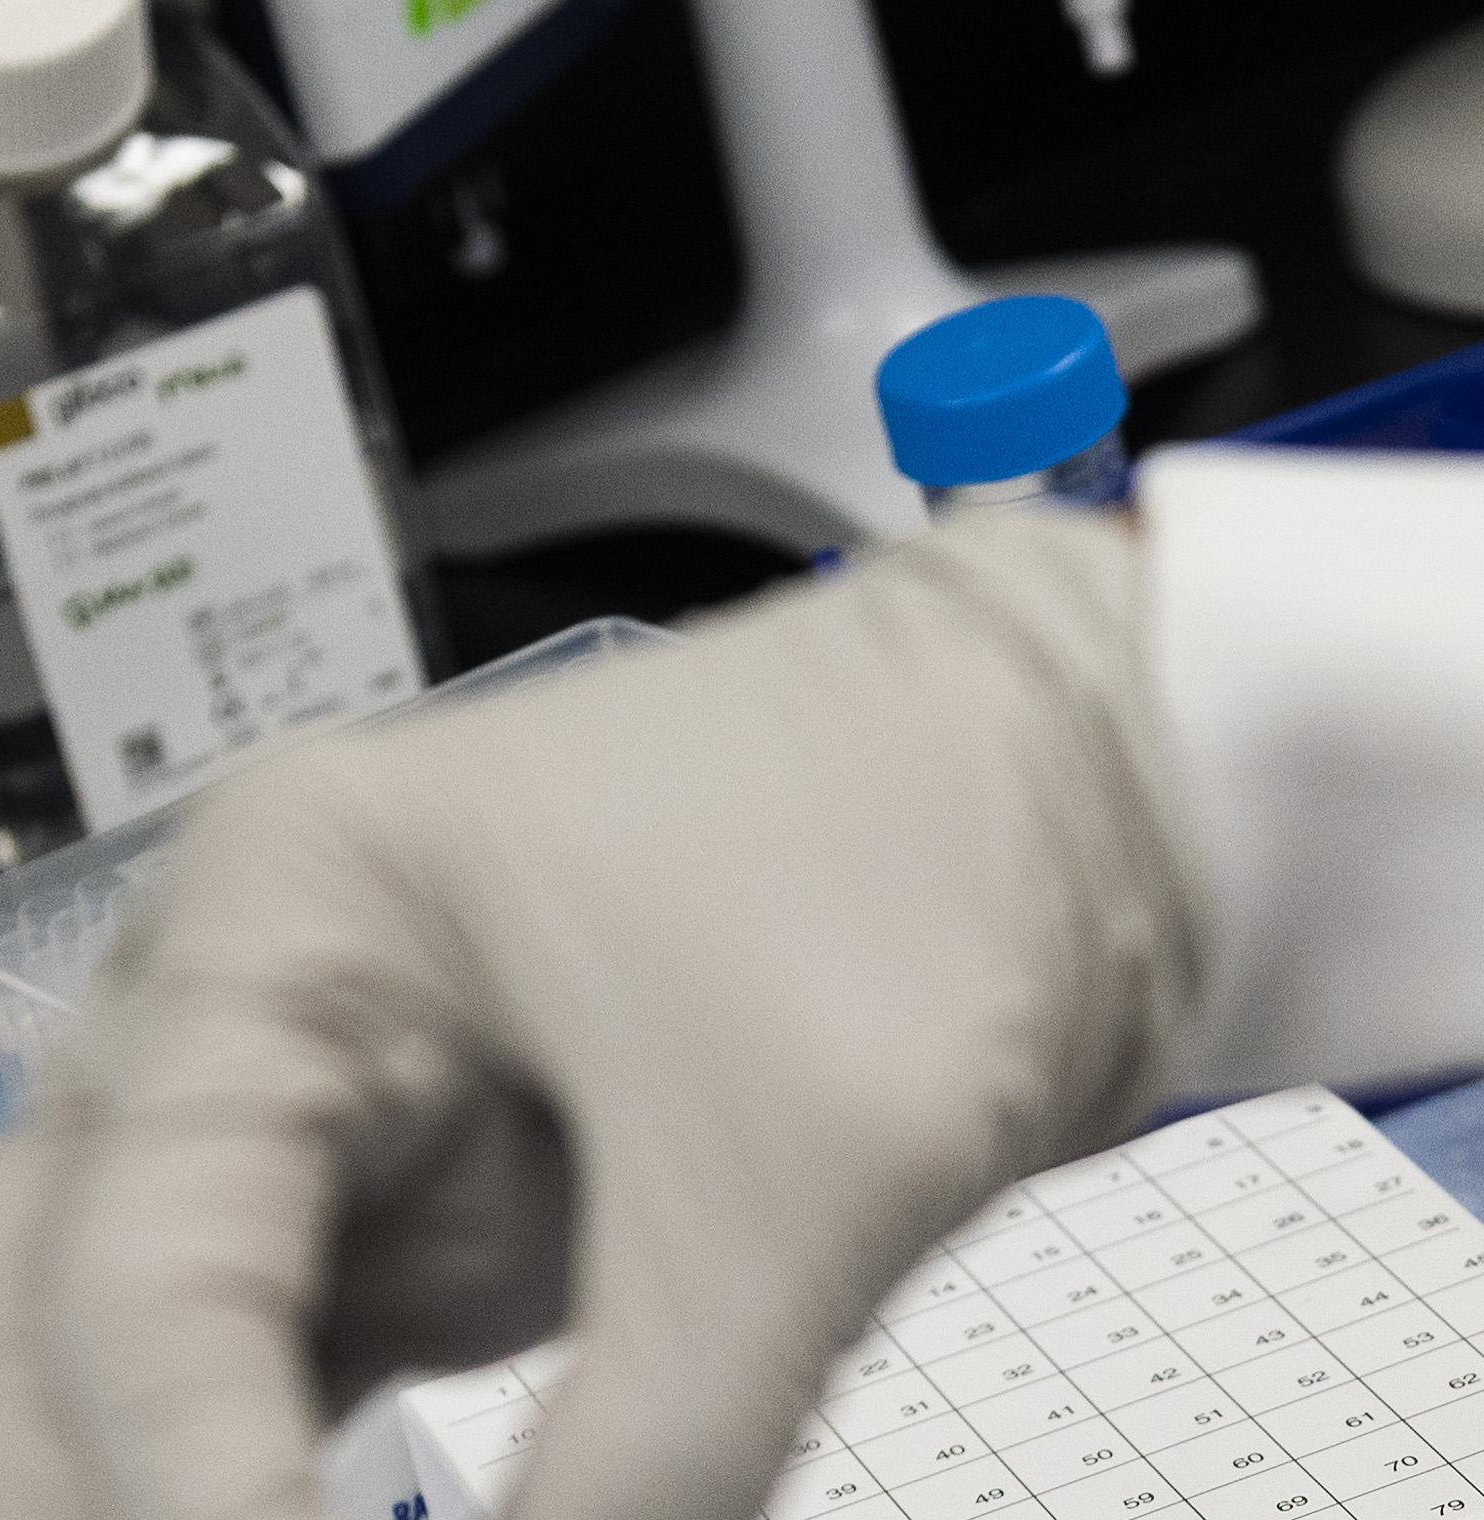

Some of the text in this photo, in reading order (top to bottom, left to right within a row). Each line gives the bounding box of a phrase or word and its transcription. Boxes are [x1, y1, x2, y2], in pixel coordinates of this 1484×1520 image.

[859, 1175, 1406, 1378] 22 23 24 25 26 27
[1032, 1246, 1061, 1262] 15
[1132, 1208, 1164, 1225] 16
[900, 1400, 930, 1417] 31
[1002, 1363, 1034, 1381] 32
[1107, 1326, 1140, 1344] 33
[1212, 1288, 1243, 1306] 34
[1315, 1251, 1348, 1269] 35
[1418, 1214, 1450, 1230] 36
[825, 1483, 858, 1499] 39
[935, 1444, 967, 1461] 40
[1047, 1404, 1075, 1421] 41
[1150, 1367, 1180, 1384] 42
[1255, 1329, 1286, 1346] 43
[1360, 1291, 1390, 1307] 44
[975, 1488, 1005, 1504] 49
[1081, 1448, 1114, 1466] 50
[1193, 1408, 1224, 1426] 51
[1296, 1370, 1329, 1388] 52
[1402, 1331, 1436, 1349] 53
[1122, 1492, 1156, 1510] 59
[1232, 1452, 1265, 1469] 60
[1344, 1411, 1375, 1428] 61
[1447, 1372, 1480, 1390] 62
[1275, 1495, 1309, 1512] 69
[1384, 1455, 1419, 1473] 70
[1431, 1499, 1466, 1517] 79
